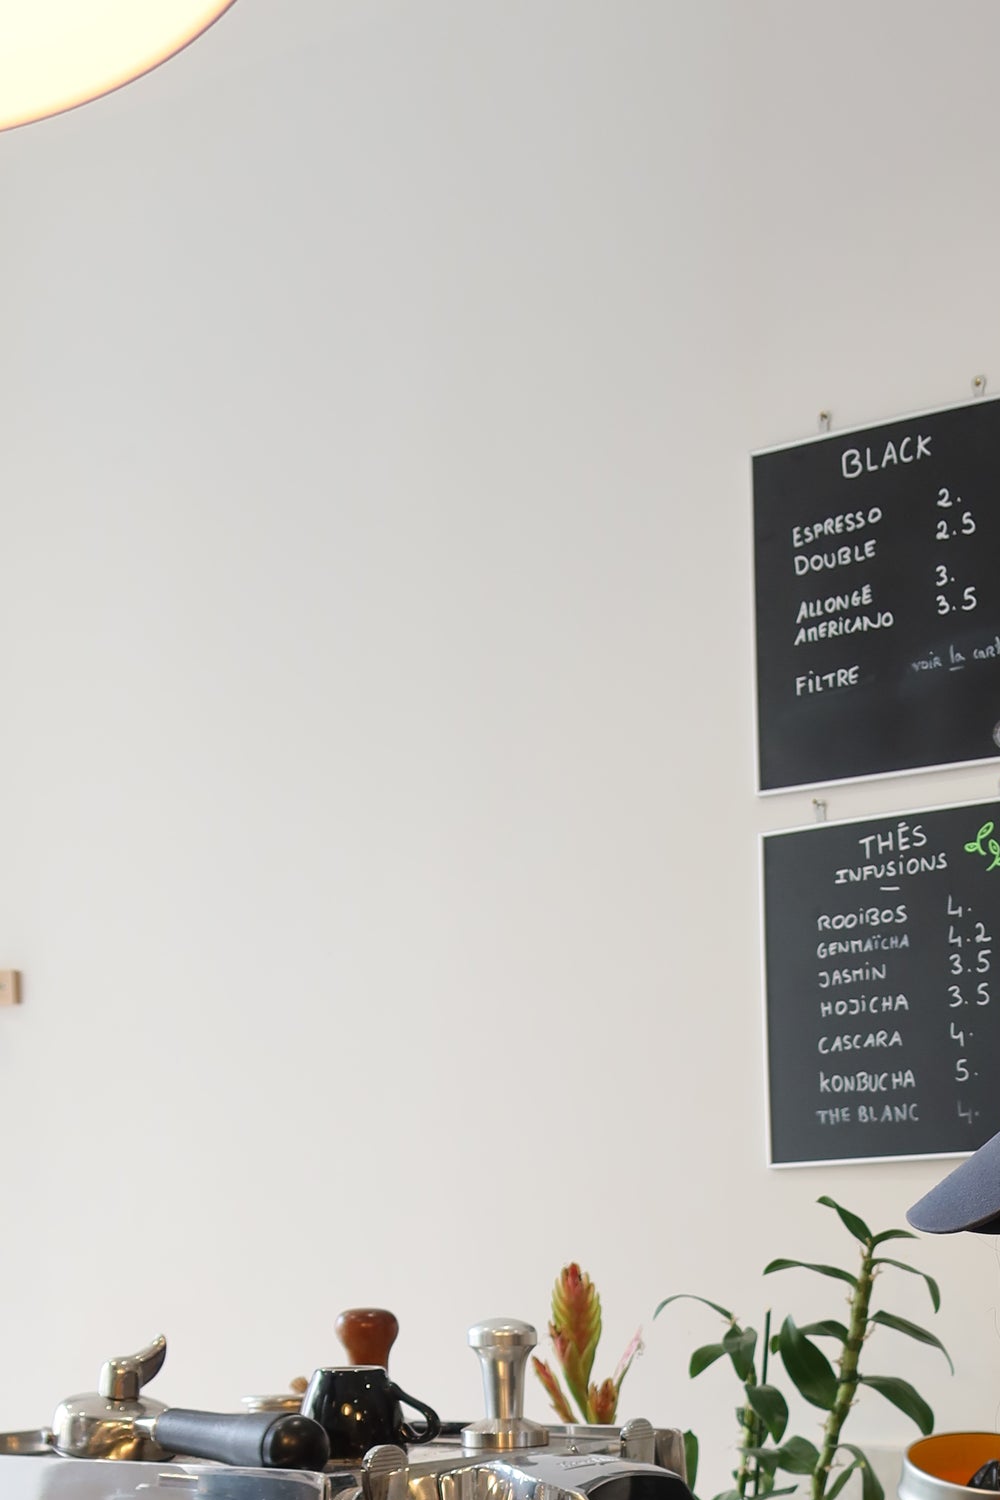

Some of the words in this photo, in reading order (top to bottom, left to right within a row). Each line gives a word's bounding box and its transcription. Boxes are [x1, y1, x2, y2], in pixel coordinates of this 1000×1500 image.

[841, 434, 932, 479] BLACK
[792, 507, 882, 548] ESPRESSO
[935, 511, 976, 540] 2.5
[794, 539, 876, 576] DOUBLE
[935, 586, 977, 615] 3.5
[793, 611, 894, 646] AMERICANO
[795, 665, 860, 696] FILTRE
[834, 853, 948, 884] INFUSIONS
[817, 904, 908, 931] ROOIBOS
[948, 922, 992, 948] 4.2
[817, 961, 886, 988] JASMIN
[949, 949, 992, 975] 3.5
[820, 994, 909, 1018] HOJICHA
[947, 982, 990, 1008] 3.5
[817, 1030, 903, 1055] CASCARA
[819, 1069, 916, 1093] KONBUCHA
[857, 1103, 919, 1123] BLANC
